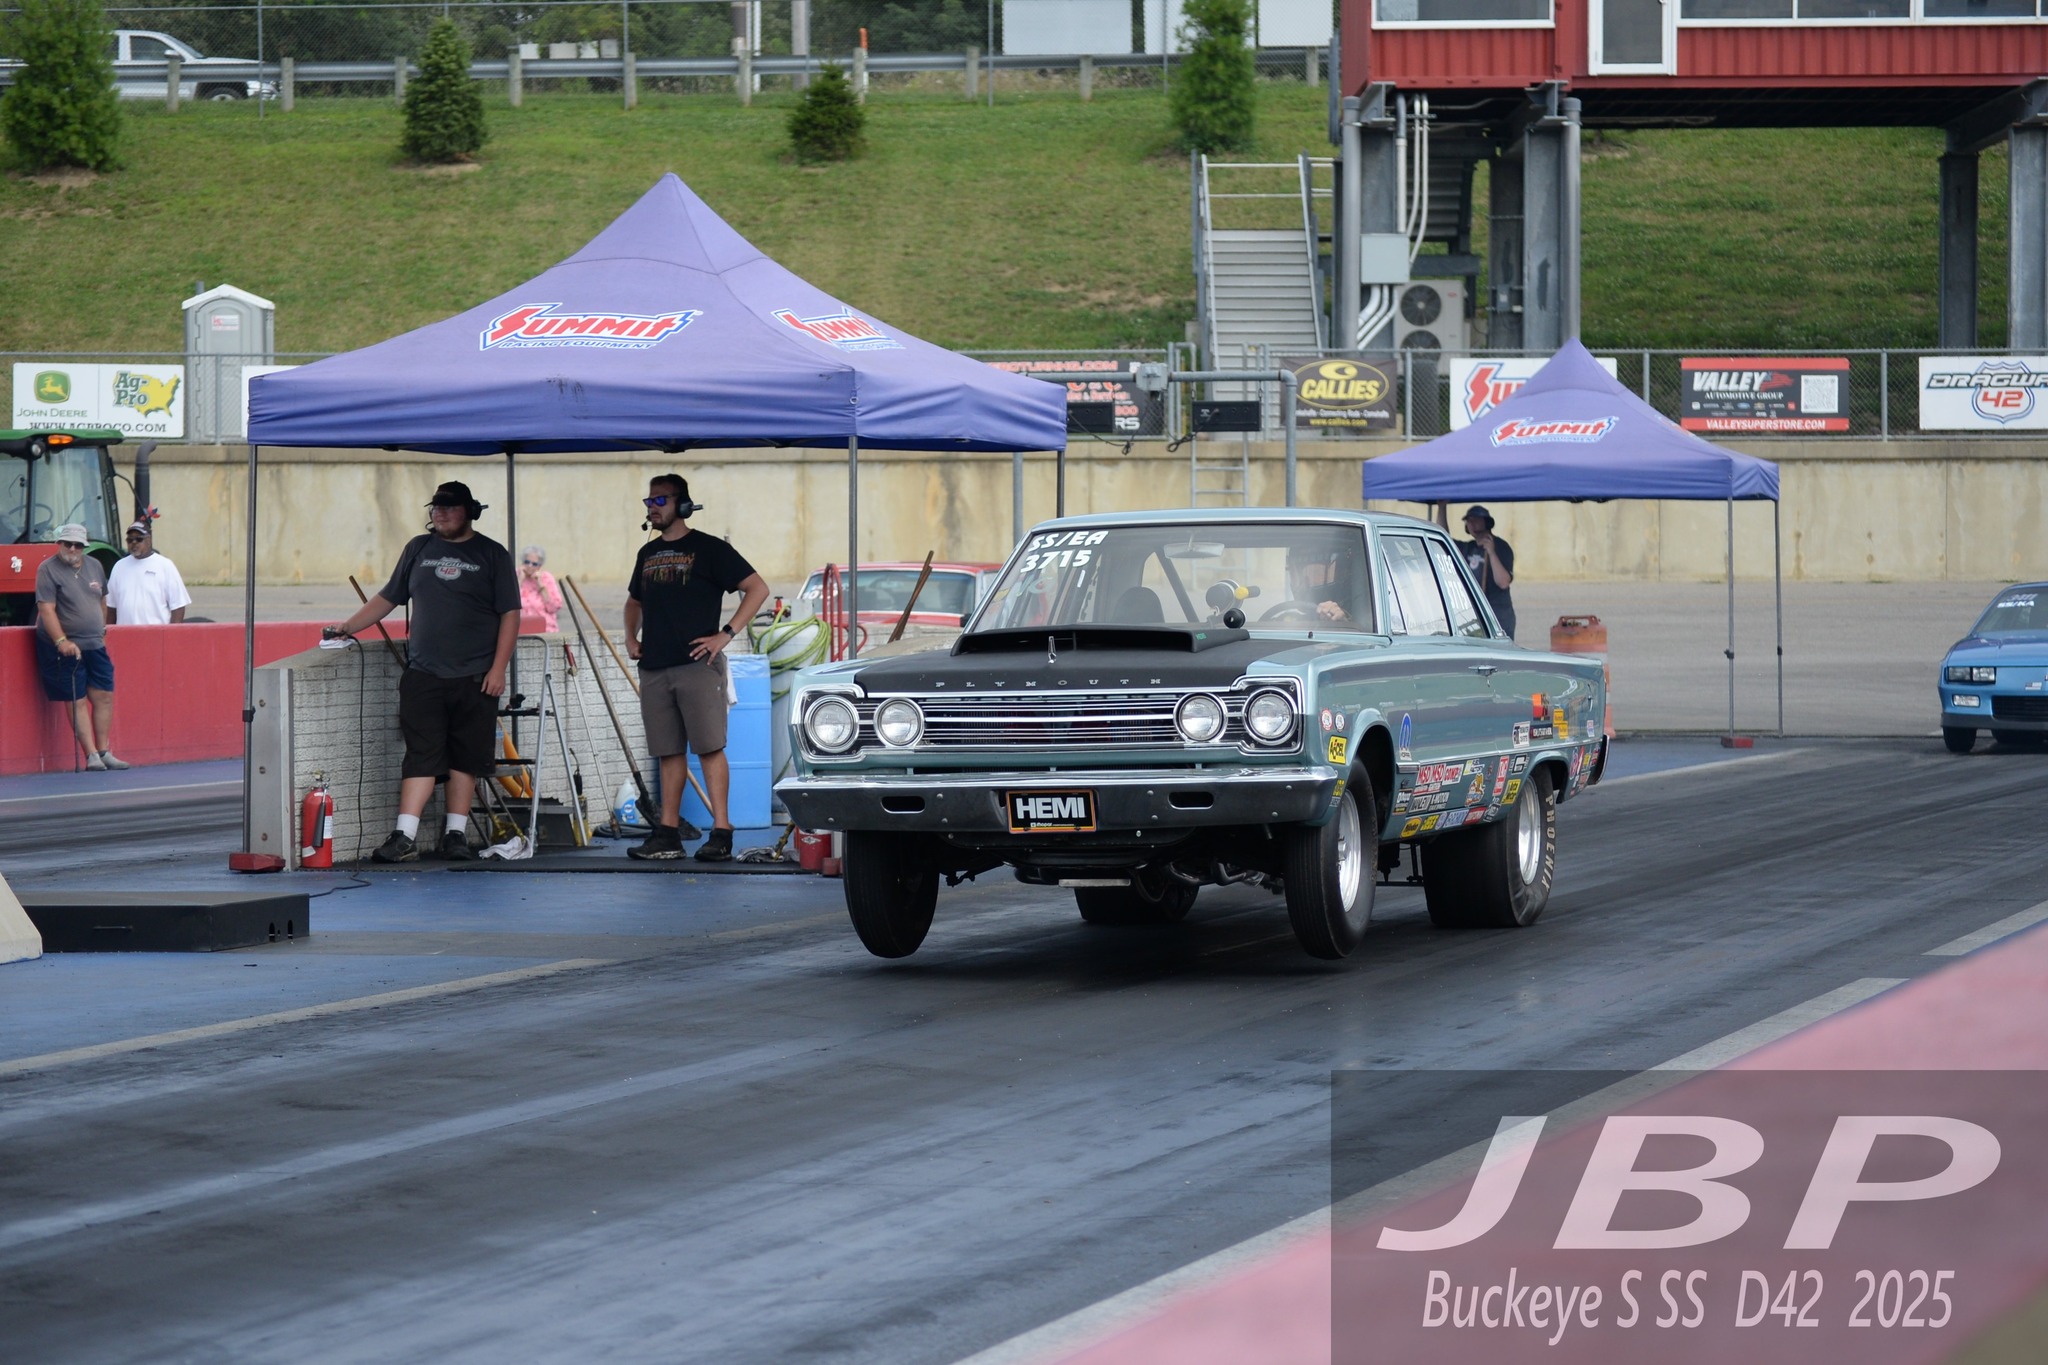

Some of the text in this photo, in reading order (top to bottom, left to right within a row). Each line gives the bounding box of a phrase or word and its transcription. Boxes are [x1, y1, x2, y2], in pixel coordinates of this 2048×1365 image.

[486, 305, 688, 345] SUMMIT
[501, 340, 656, 349] RACING EQUIPMENT
[1301, 378, 1380, 400] CALLIES
[1693, 371, 1767, 392] VALLEY
[114, 389, 148, 406] Pro
[1705, 392, 1784, 400] AUTOMOTIVE GROUP
[1982, 390, 2024, 408] 42
[16, 407, 88, 418] JOHN DEERE
[1706, 419, 1826, 430] VALLEYSUPERSTORE.COM
[1028, 530, 1109, 552] SS/EA
[1020, 549, 1092, 573] 3715
[440, 567, 458, 575] 42
[936, 678, 1161, 687] PLYMOUTH
[1417, 766, 1431, 784] MSD
[1432, 764, 1445, 782] MSD
[1016, 797, 1086, 819] HEMI
[1541, 794, 1556, 893] PHOENIX
